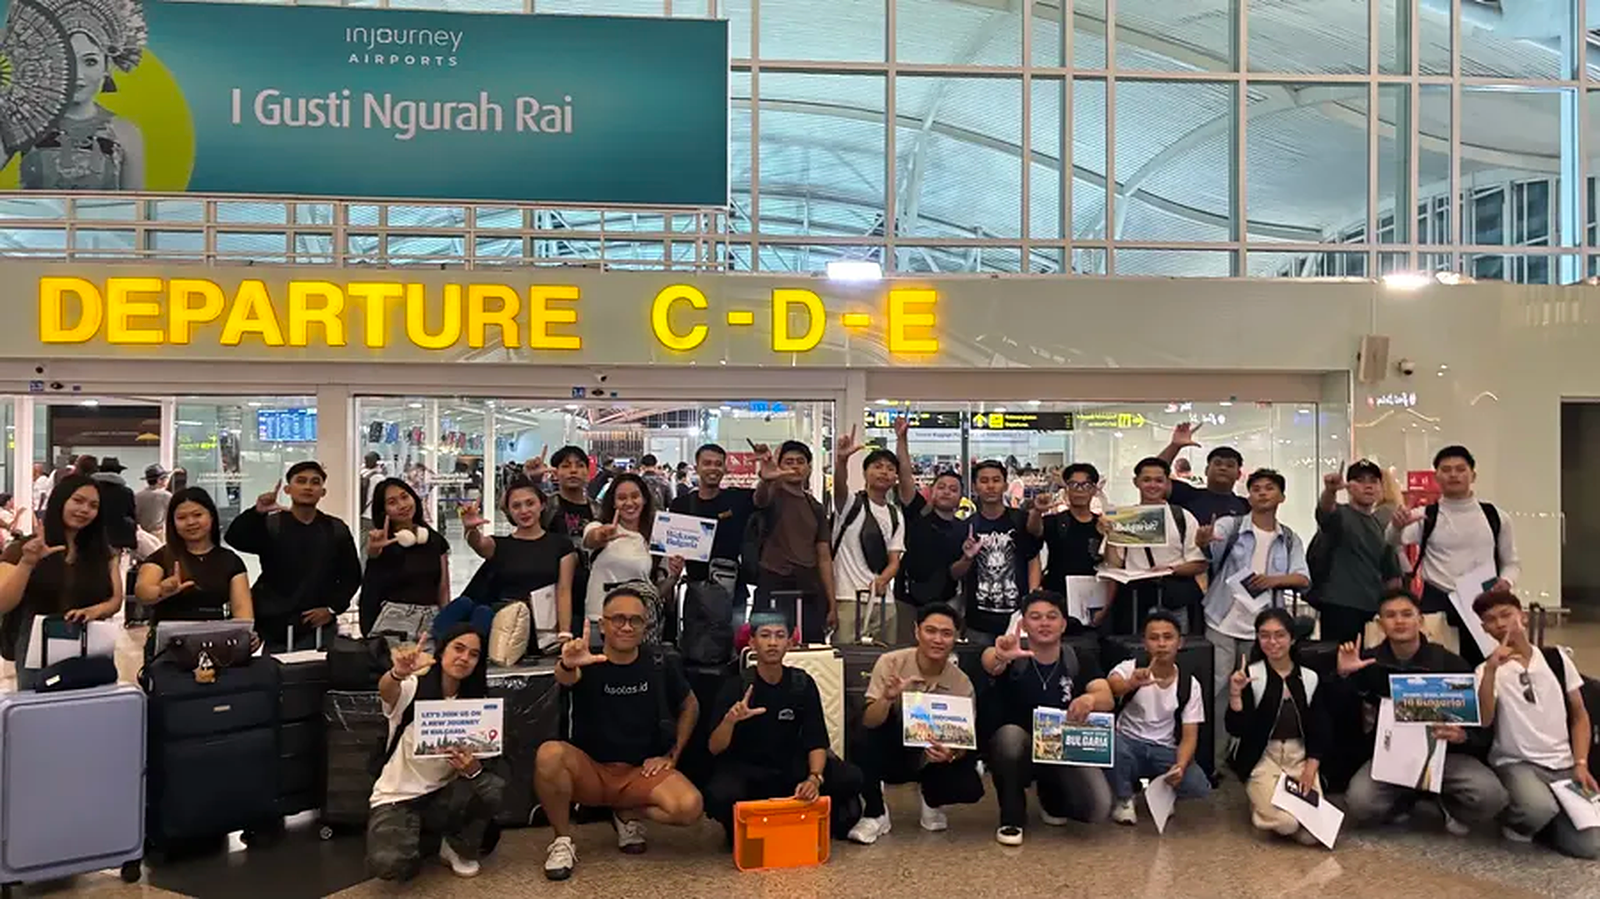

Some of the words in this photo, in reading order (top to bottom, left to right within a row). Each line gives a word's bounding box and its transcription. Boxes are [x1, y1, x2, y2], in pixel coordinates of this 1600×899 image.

[346, 27, 463, 51] injourney
[348, 53, 458, 66] AIRPORTS
[231, 88, 241, 124] I
[254, 89, 350, 127] Gusti
[363, 92, 502, 140] Ngurah
[516, 95, 573, 133] Rai
[38, 276, 582, 349] DEPARTURE
[1065, 735, 1109, 748] BULGARIA
